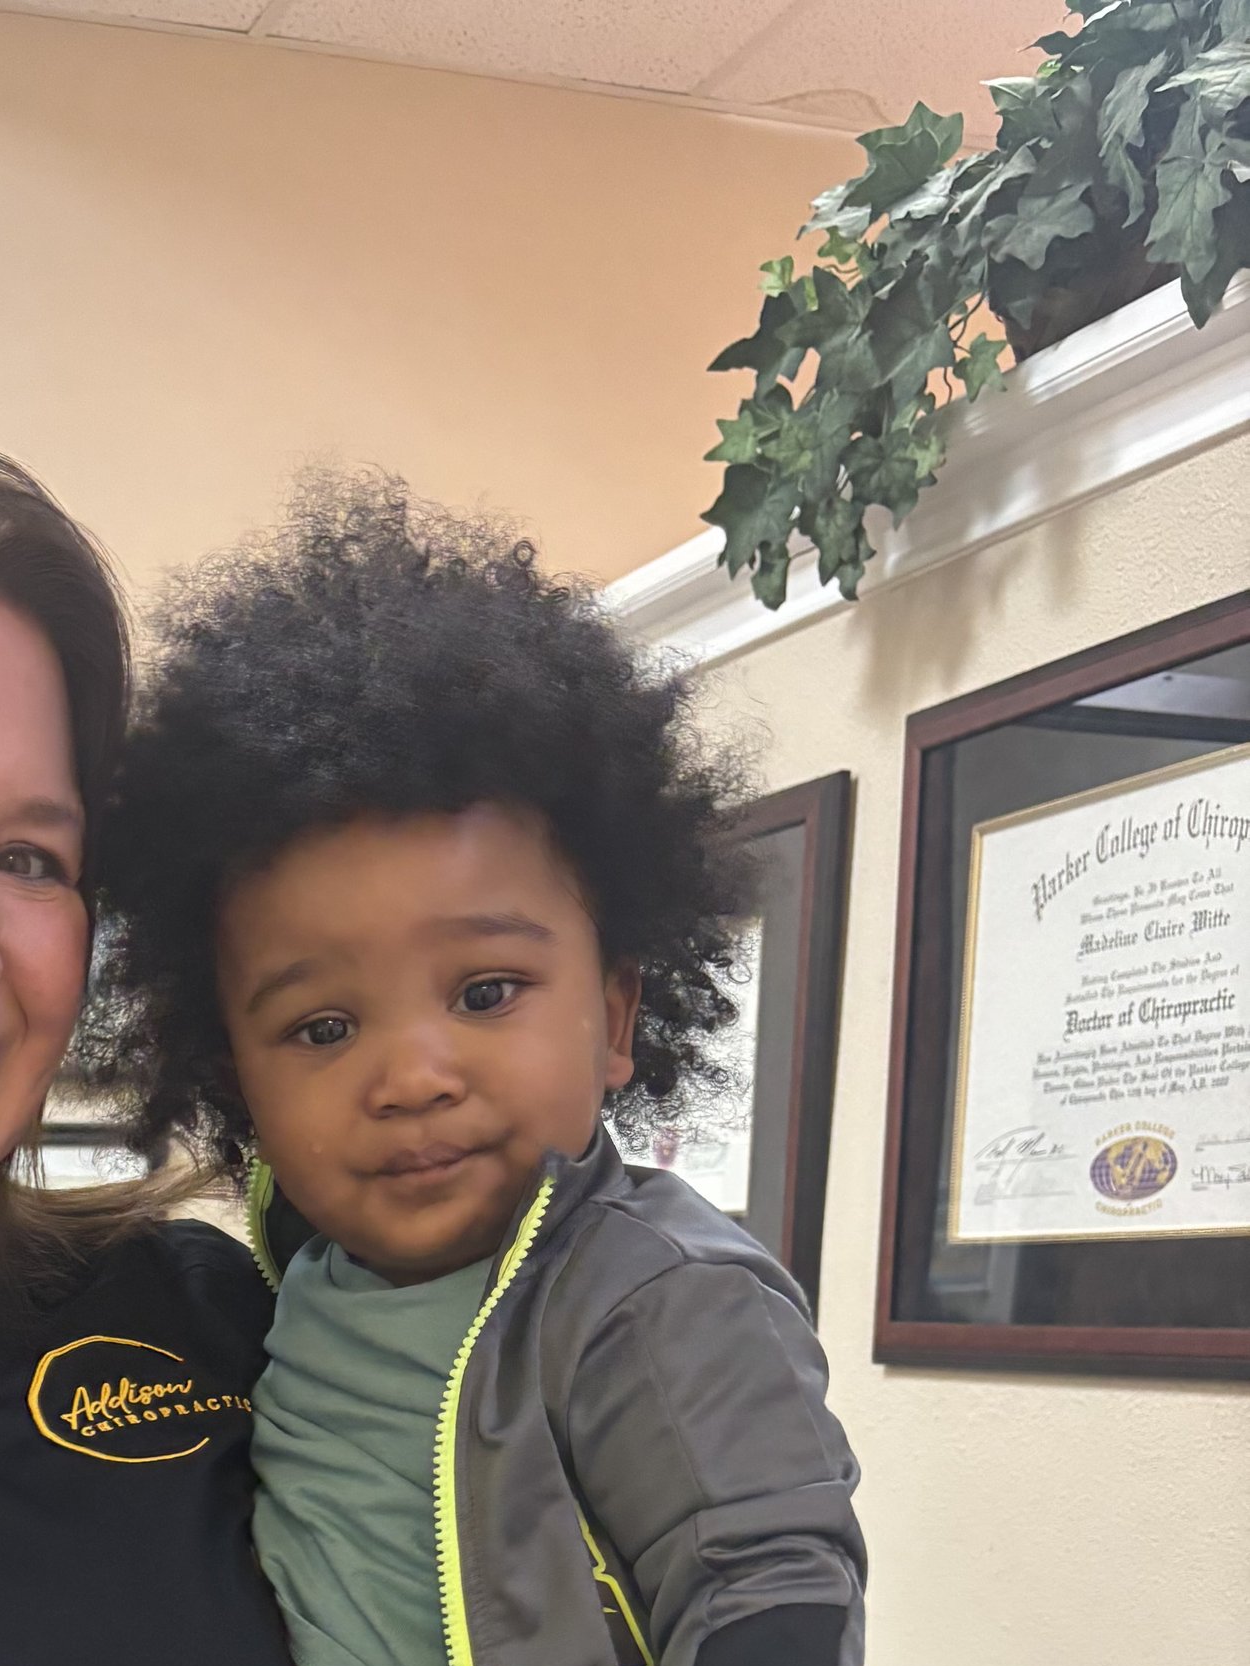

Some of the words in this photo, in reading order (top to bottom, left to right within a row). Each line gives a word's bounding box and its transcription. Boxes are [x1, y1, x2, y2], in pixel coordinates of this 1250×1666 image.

[1031, 850, 1090, 921] Parker
[1095, 816, 1158, 864] College
[1162, 803, 1184, 841] of
[1187, 798, 1250, 852] Chirop
[1076, 929, 1138, 960] Madeline
[1144, 919, 1185, 943] Claire
[1189, 907, 1231, 940] Witte
[1063, 1008, 1114, 1042] Doctor
[1118, 1001, 1135, 1027] of
[1138, 987, 1236, 1028] Chiropractic
[60, 1377, 193, 1431] Addison
